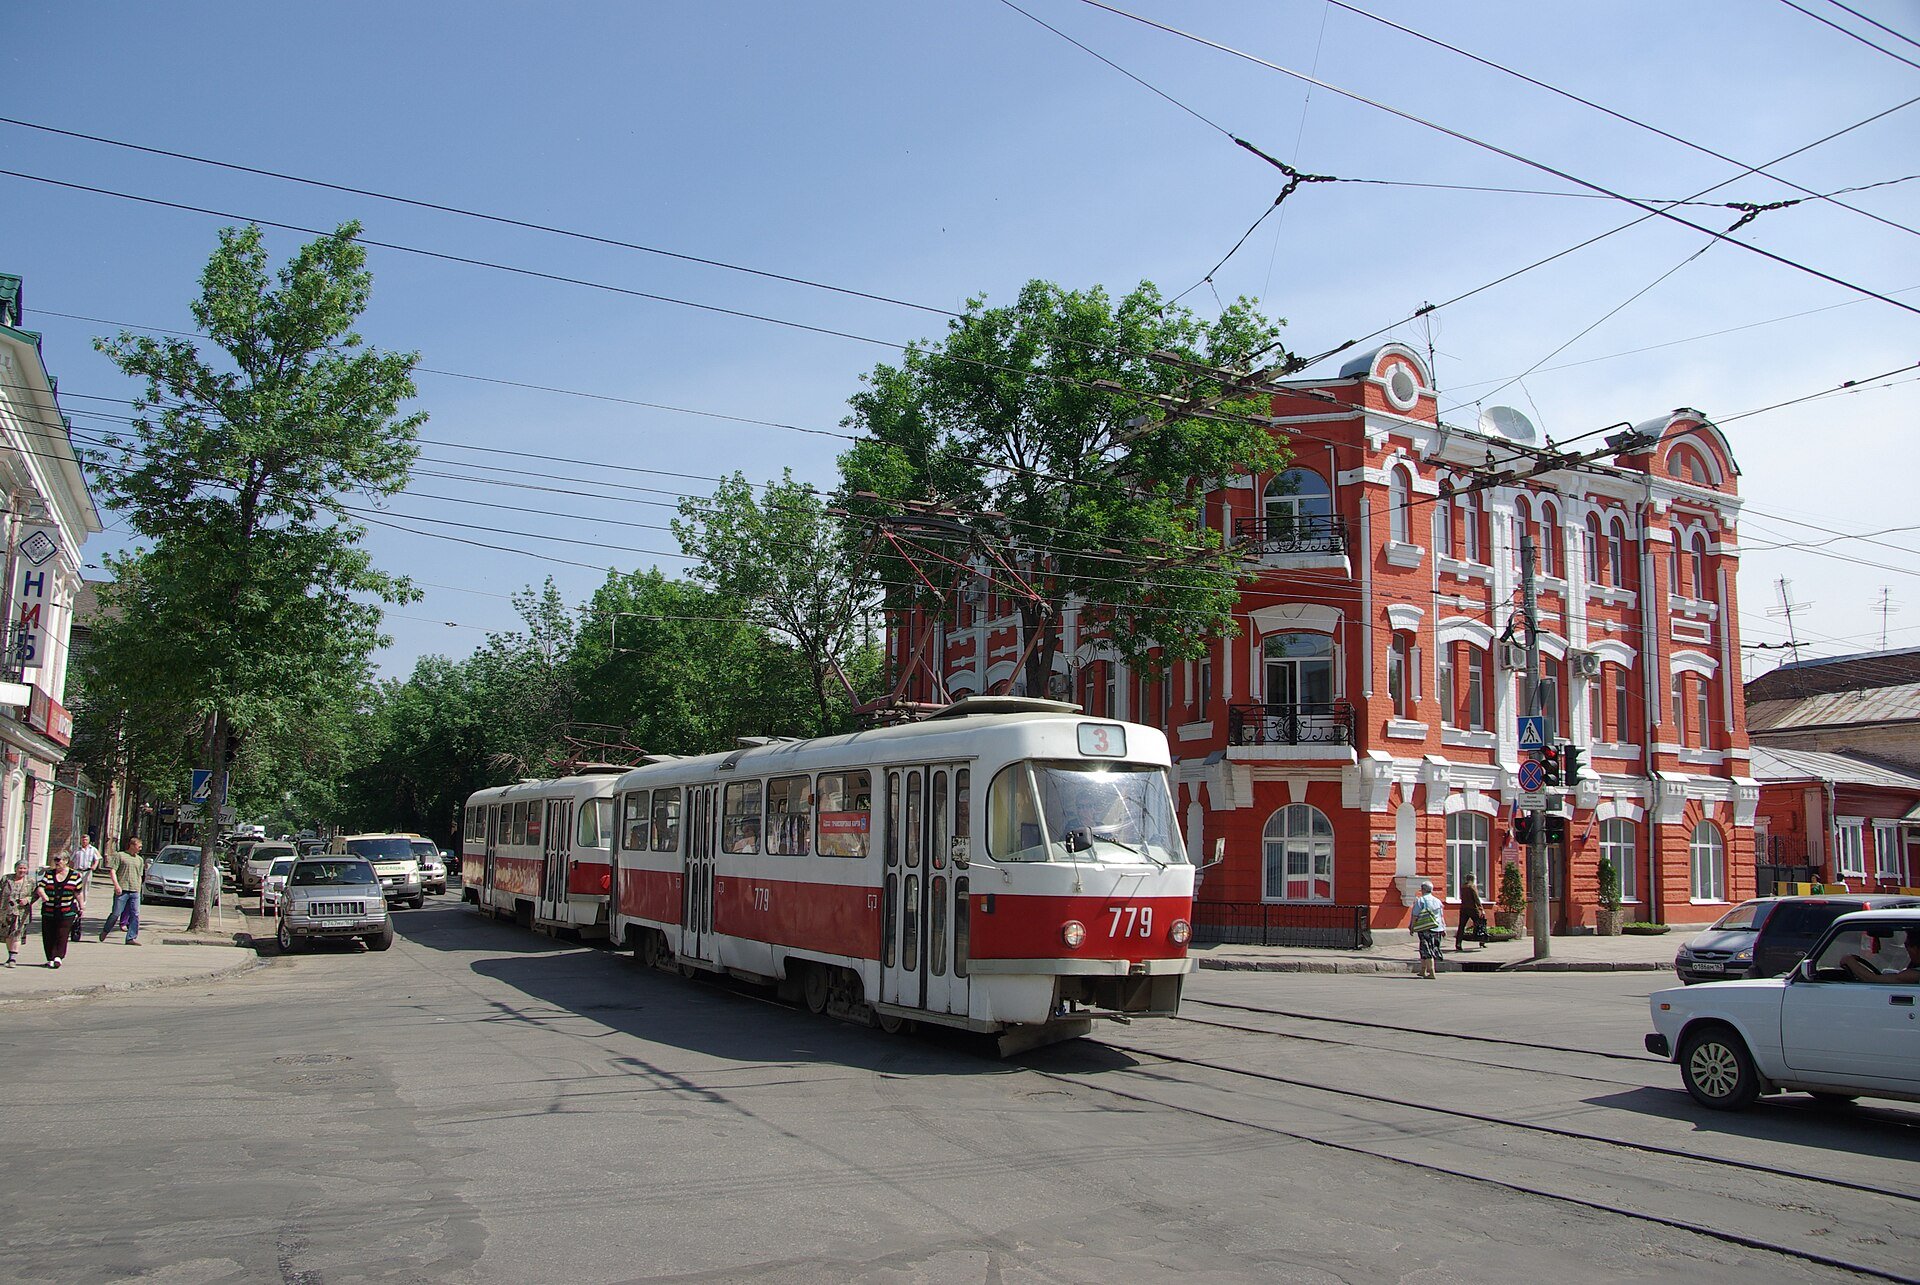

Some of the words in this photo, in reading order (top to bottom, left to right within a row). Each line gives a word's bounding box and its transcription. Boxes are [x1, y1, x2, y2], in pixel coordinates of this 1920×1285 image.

[1093, 728, 1109, 753] 3
[754, 887, 769, 912] 779
[1108, 907, 1152, 938] 779
